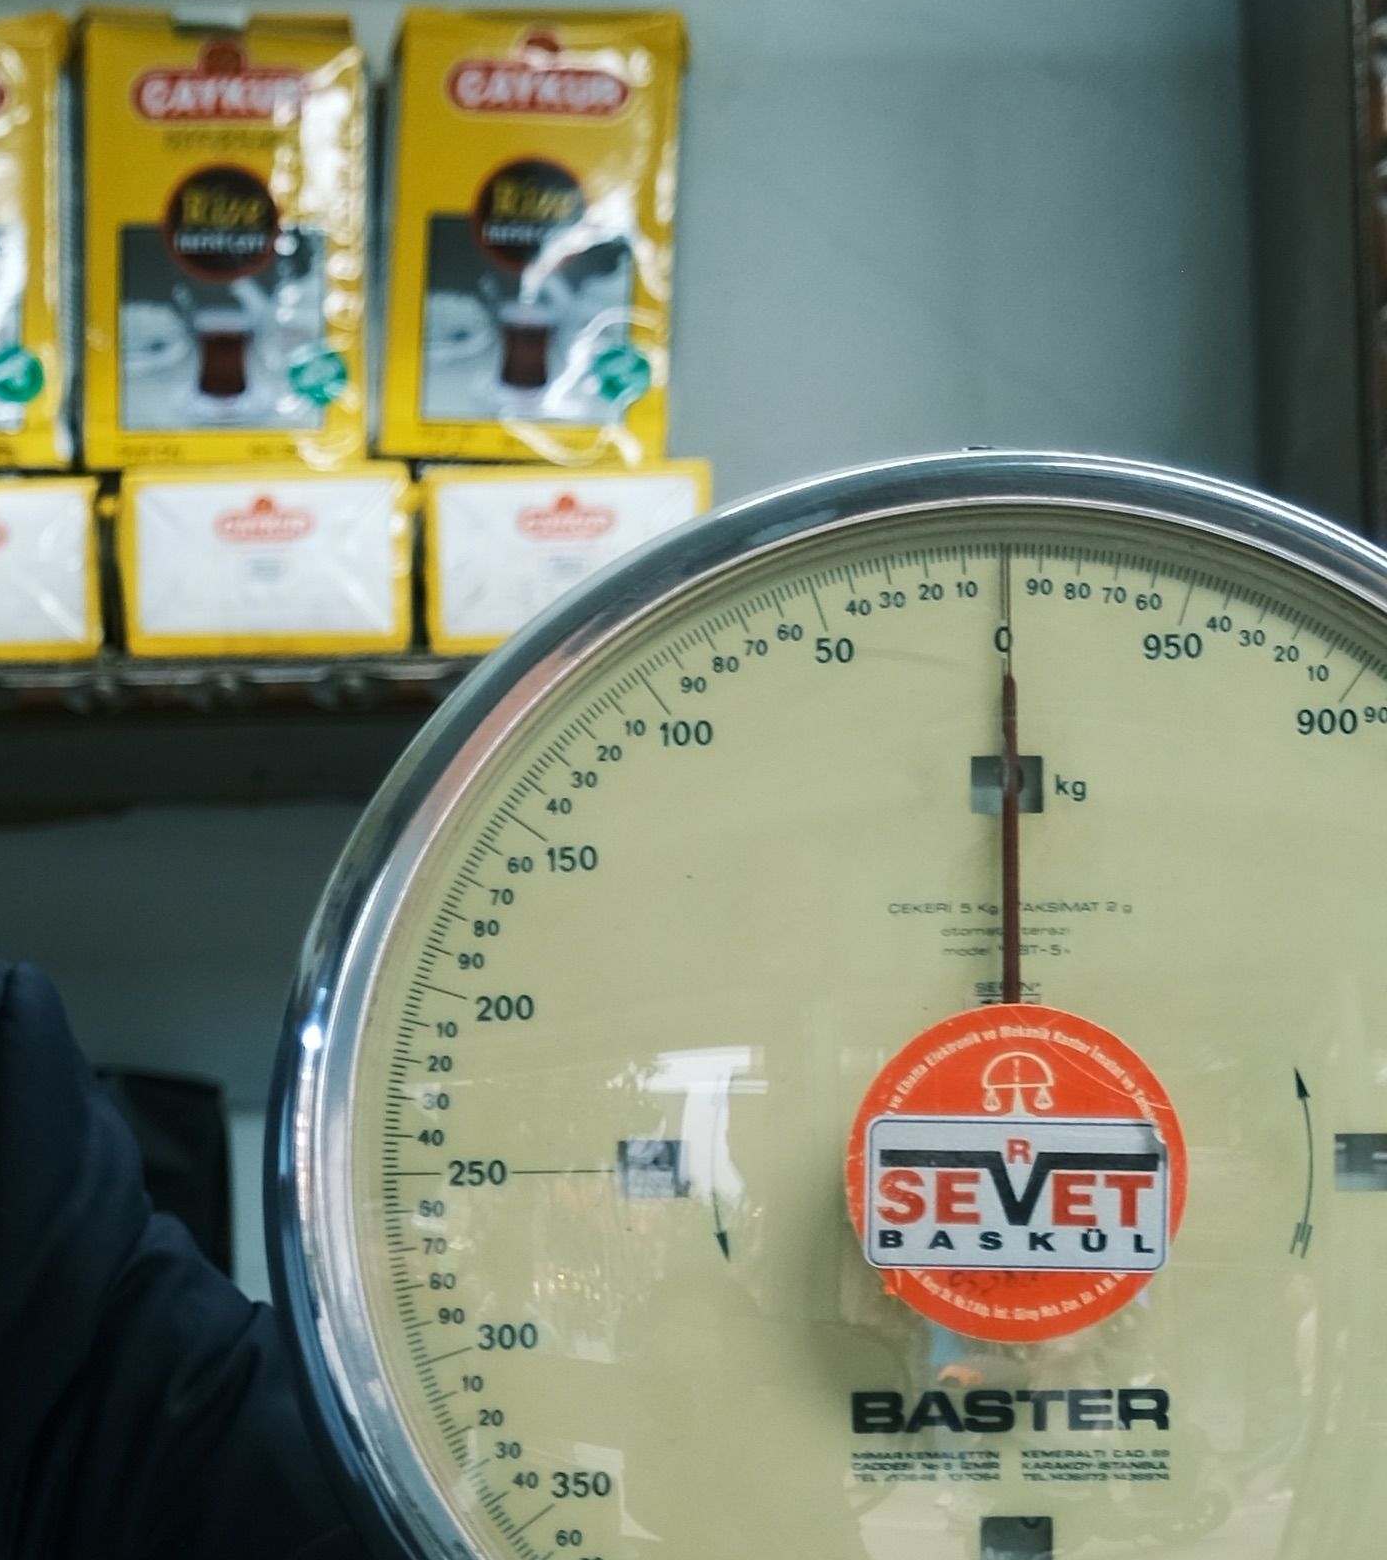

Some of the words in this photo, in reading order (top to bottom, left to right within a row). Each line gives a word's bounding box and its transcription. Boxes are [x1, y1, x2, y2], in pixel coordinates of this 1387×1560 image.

[919, 583, 944, 600] 20
[956, 581, 978, 598] 10
[1026, 578, 1053, 595] 90
[1064, 582, 1091, 599] 80
[1102, 587, 1127, 603] 70
[845, 599, 872, 616] 40
[879, 591, 906, 608] 30
[1135, 593, 1162, 610] 60
[1206, 615, 1232, 632] 40
[777, 624, 803, 641] 60
[995, 626, 1012, 652] 0
[1239, 630, 1265, 647] 30
[744, 639, 768, 656] 70
[815, 638, 854, 663] 50
[1143, 633, 1203, 659] 950
[1274, 645, 1299, 662] 20
[712, 656, 739, 673] 80
[1307, 664, 1329, 682] 10
[680, 676, 707, 693] 90
[1297, 708, 1358, 735] 900
[1364, 706, 1387, 723] 90
[625, 719, 647, 736] 10
[659, 720, 714, 746] 100
[597, 745, 622, 761] 20
[571, 771, 598, 788] 30
[1055, 774, 1087, 801] kg
[546, 798, 572, 815] 40
[507, 856, 533, 873] 60
[546, 845, 598, 871] 150
[490, 888, 514, 905] 70
[473, 919, 500, 936] 80
[458, 953, 485, 970] 90
[475, 995, 534, 1021] 200
[436, 1022, 458, 1038] 10
[427, 1055, 453, 1072] 20
[423, 1092, 450, 1110] 30
[418, 1129, 445, 1146] 40
[1006, 1139, 1031, 1164] R
[448, 1160, 507, 1186] 250
[878, 1150, 1159, 1228] SEVET
[419, 1200, 445, 1217] 60
[423, 1238, 447, 1254] 70
[878, 1228, 1154, 1254] BASKÜL
[429, 1272, 456, 1289] 80
[438, 1307, 465, 1325] 90
[477, 1323, 538, 1350] 300
[462, 1376, 484, 1392] 10
[479, 1409, 504, 1426] 20
[851, 1388, 1170, 1433] BASTER
[495, 1442, 521, 1459] 30
[513, 1471, 539, 1489] 40
[551, 1471, 611, 1497] 350
[556, 1530, 583, 1547] 60
